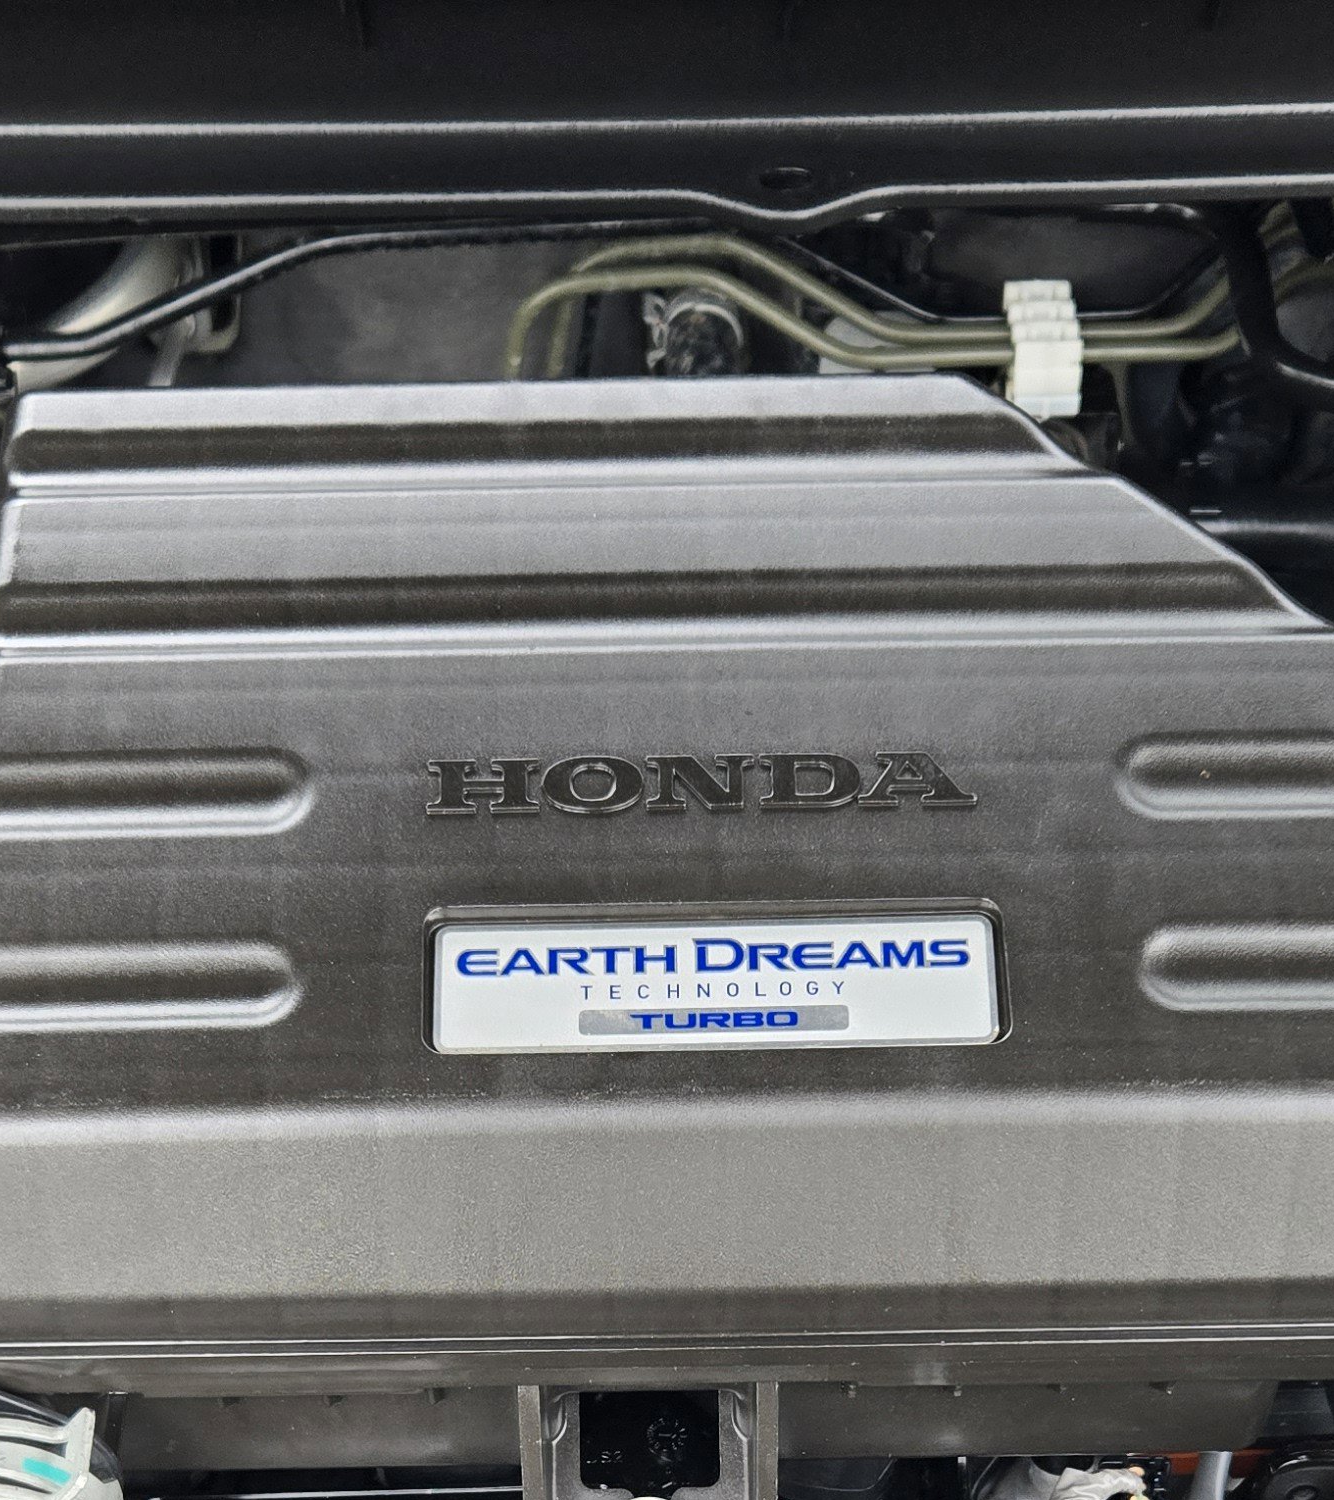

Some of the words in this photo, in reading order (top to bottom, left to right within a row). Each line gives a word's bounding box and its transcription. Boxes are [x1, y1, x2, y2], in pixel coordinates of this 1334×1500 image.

[426, 750, 978, 814] HONDA
[455, 944, 675, 978] EARTH
[694, 937, 971, 971] DREAMS
[580, 979, 847, 1001] TECHNOLOGY
[630, 1009, 799, 1030] TURBO
